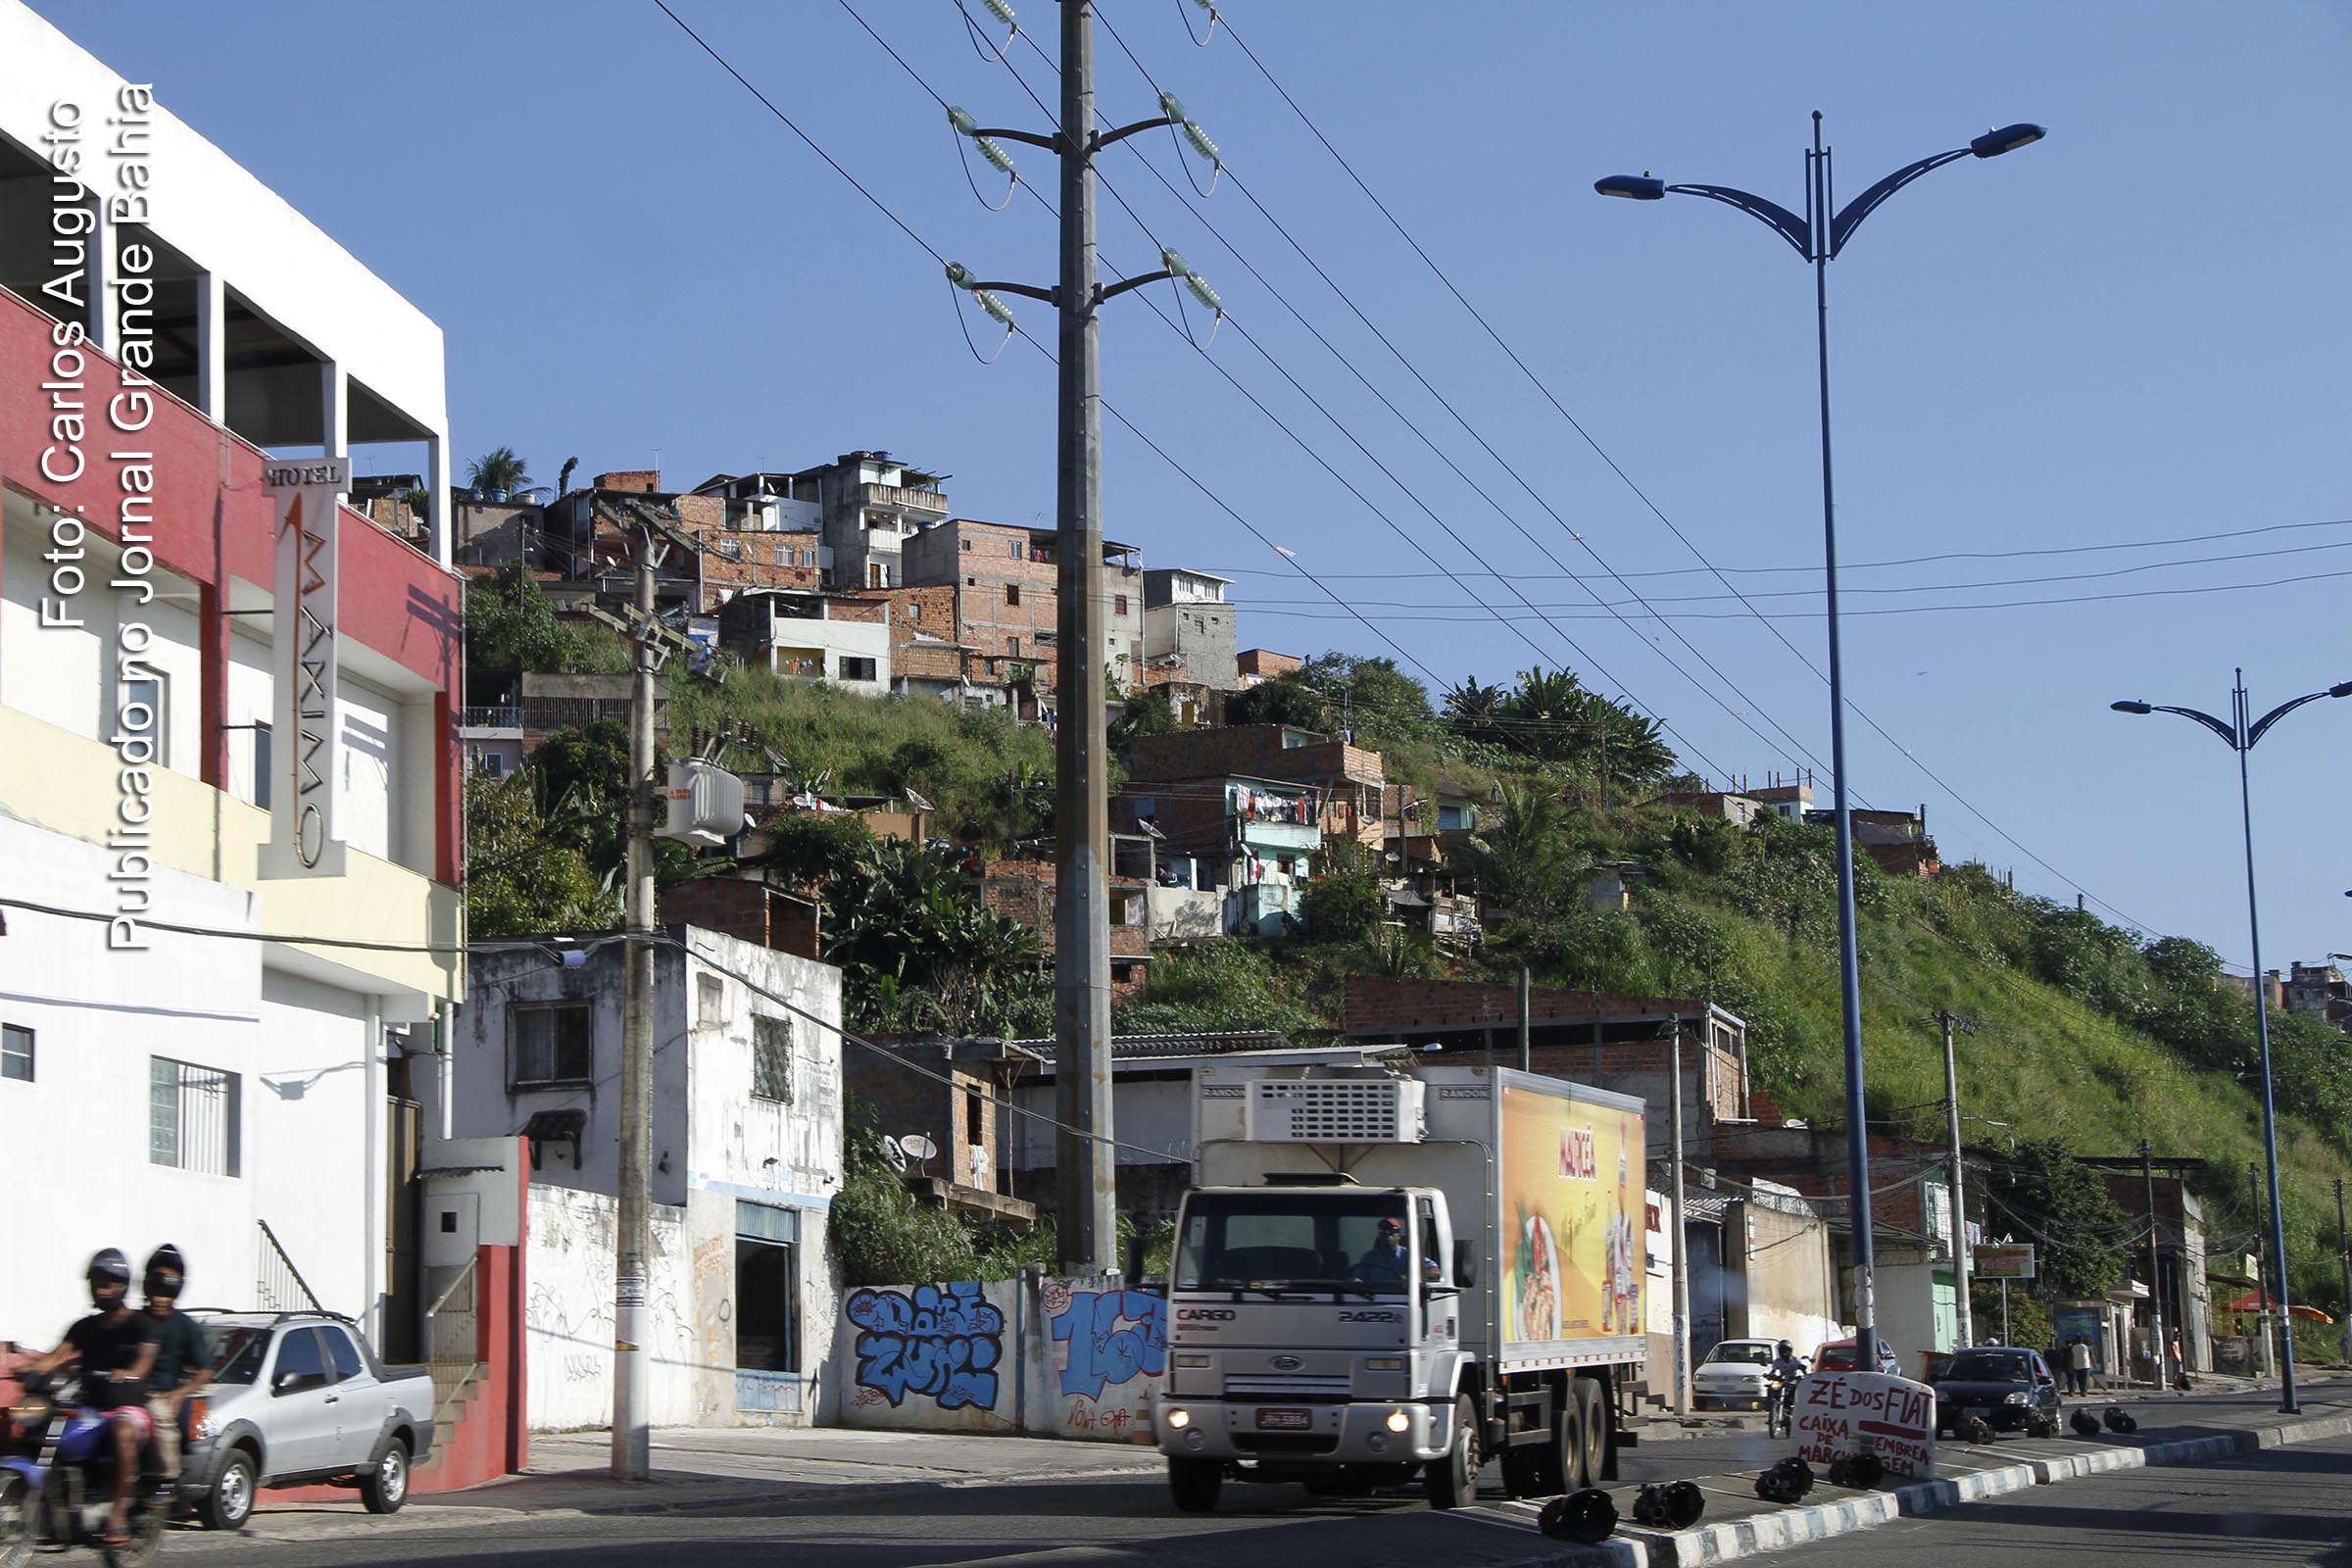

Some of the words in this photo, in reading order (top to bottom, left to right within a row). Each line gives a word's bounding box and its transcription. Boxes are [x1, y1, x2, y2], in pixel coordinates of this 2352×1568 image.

[268, 466, 342, 487] HOTEL
[1441, 1089, 1489, 1099] RANDON
[1177, 1308, 1237, 1321] CARGO
[1808, 1378, 1847, 1410] ZÉ
[1849, 1388, 1885, 1411] DOS
[1884, 1386, 1934, 1430] FIAT
[1816, 1432, 1834, 1446] DE
[1875, 1436, 1929, 1466] EMBREA
